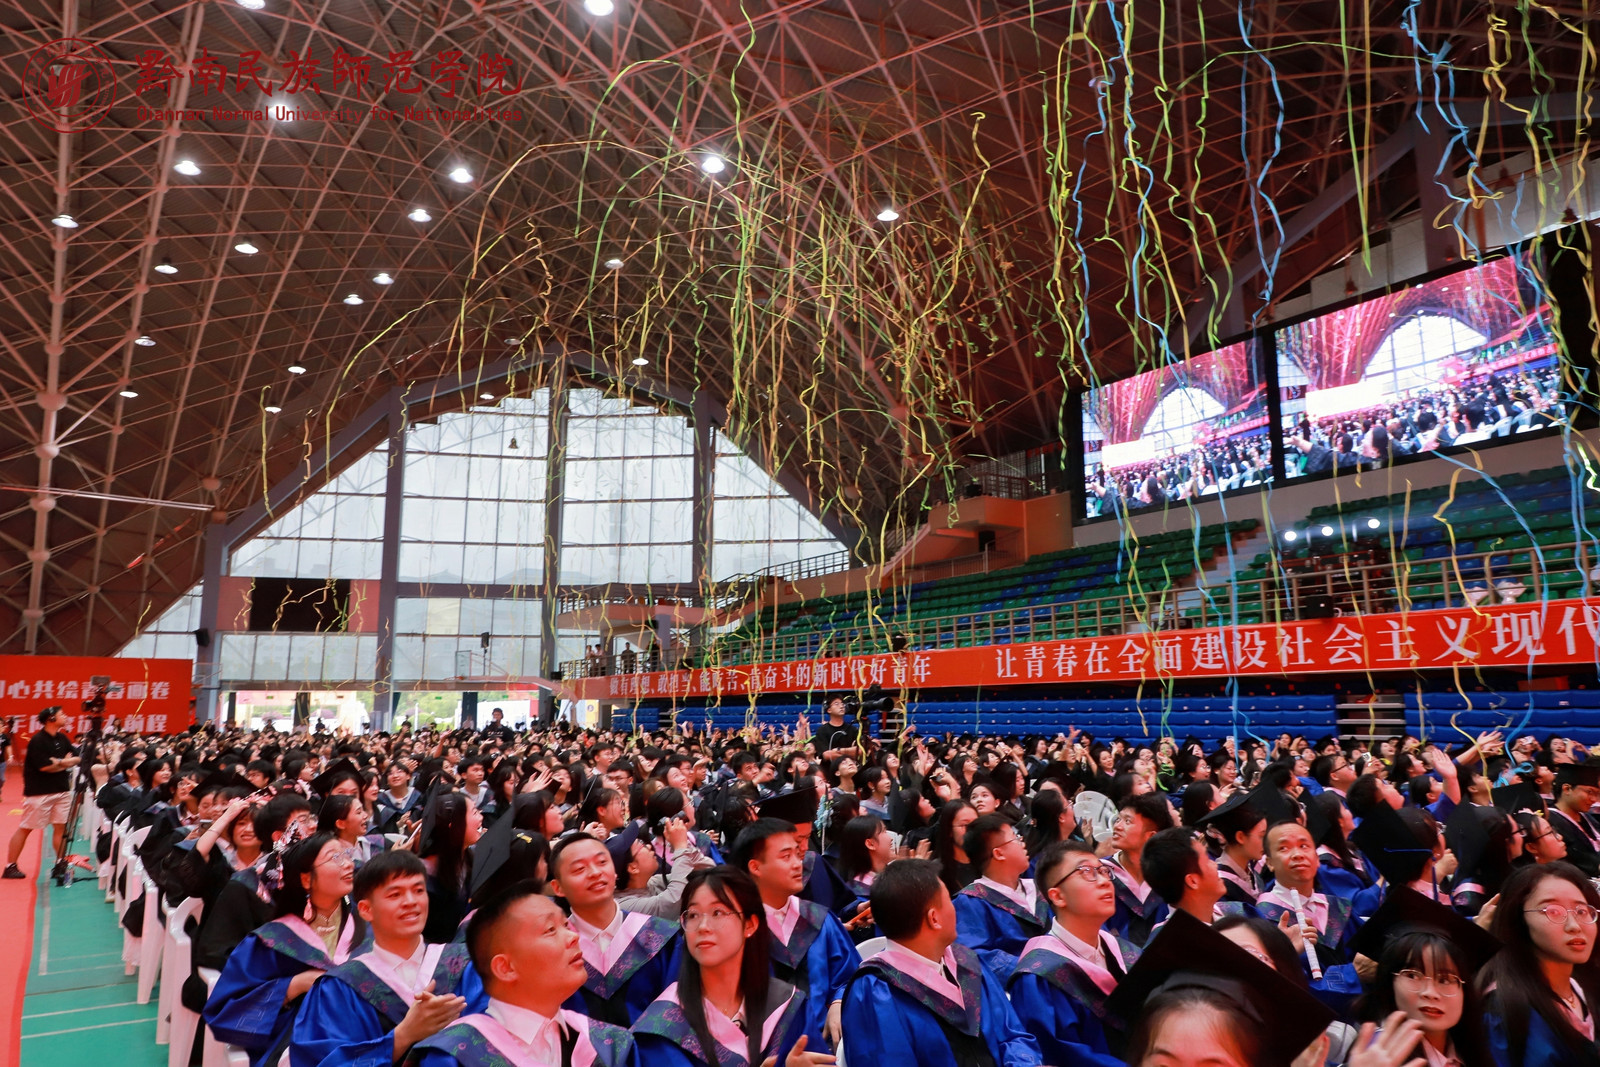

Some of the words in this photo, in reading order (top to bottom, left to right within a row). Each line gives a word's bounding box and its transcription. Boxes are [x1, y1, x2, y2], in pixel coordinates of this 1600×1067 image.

[995, 606, 1600, 679] 让青春在全面建设社会主义现代
[0, 680, 170, 700] 心共绘青春画卷
